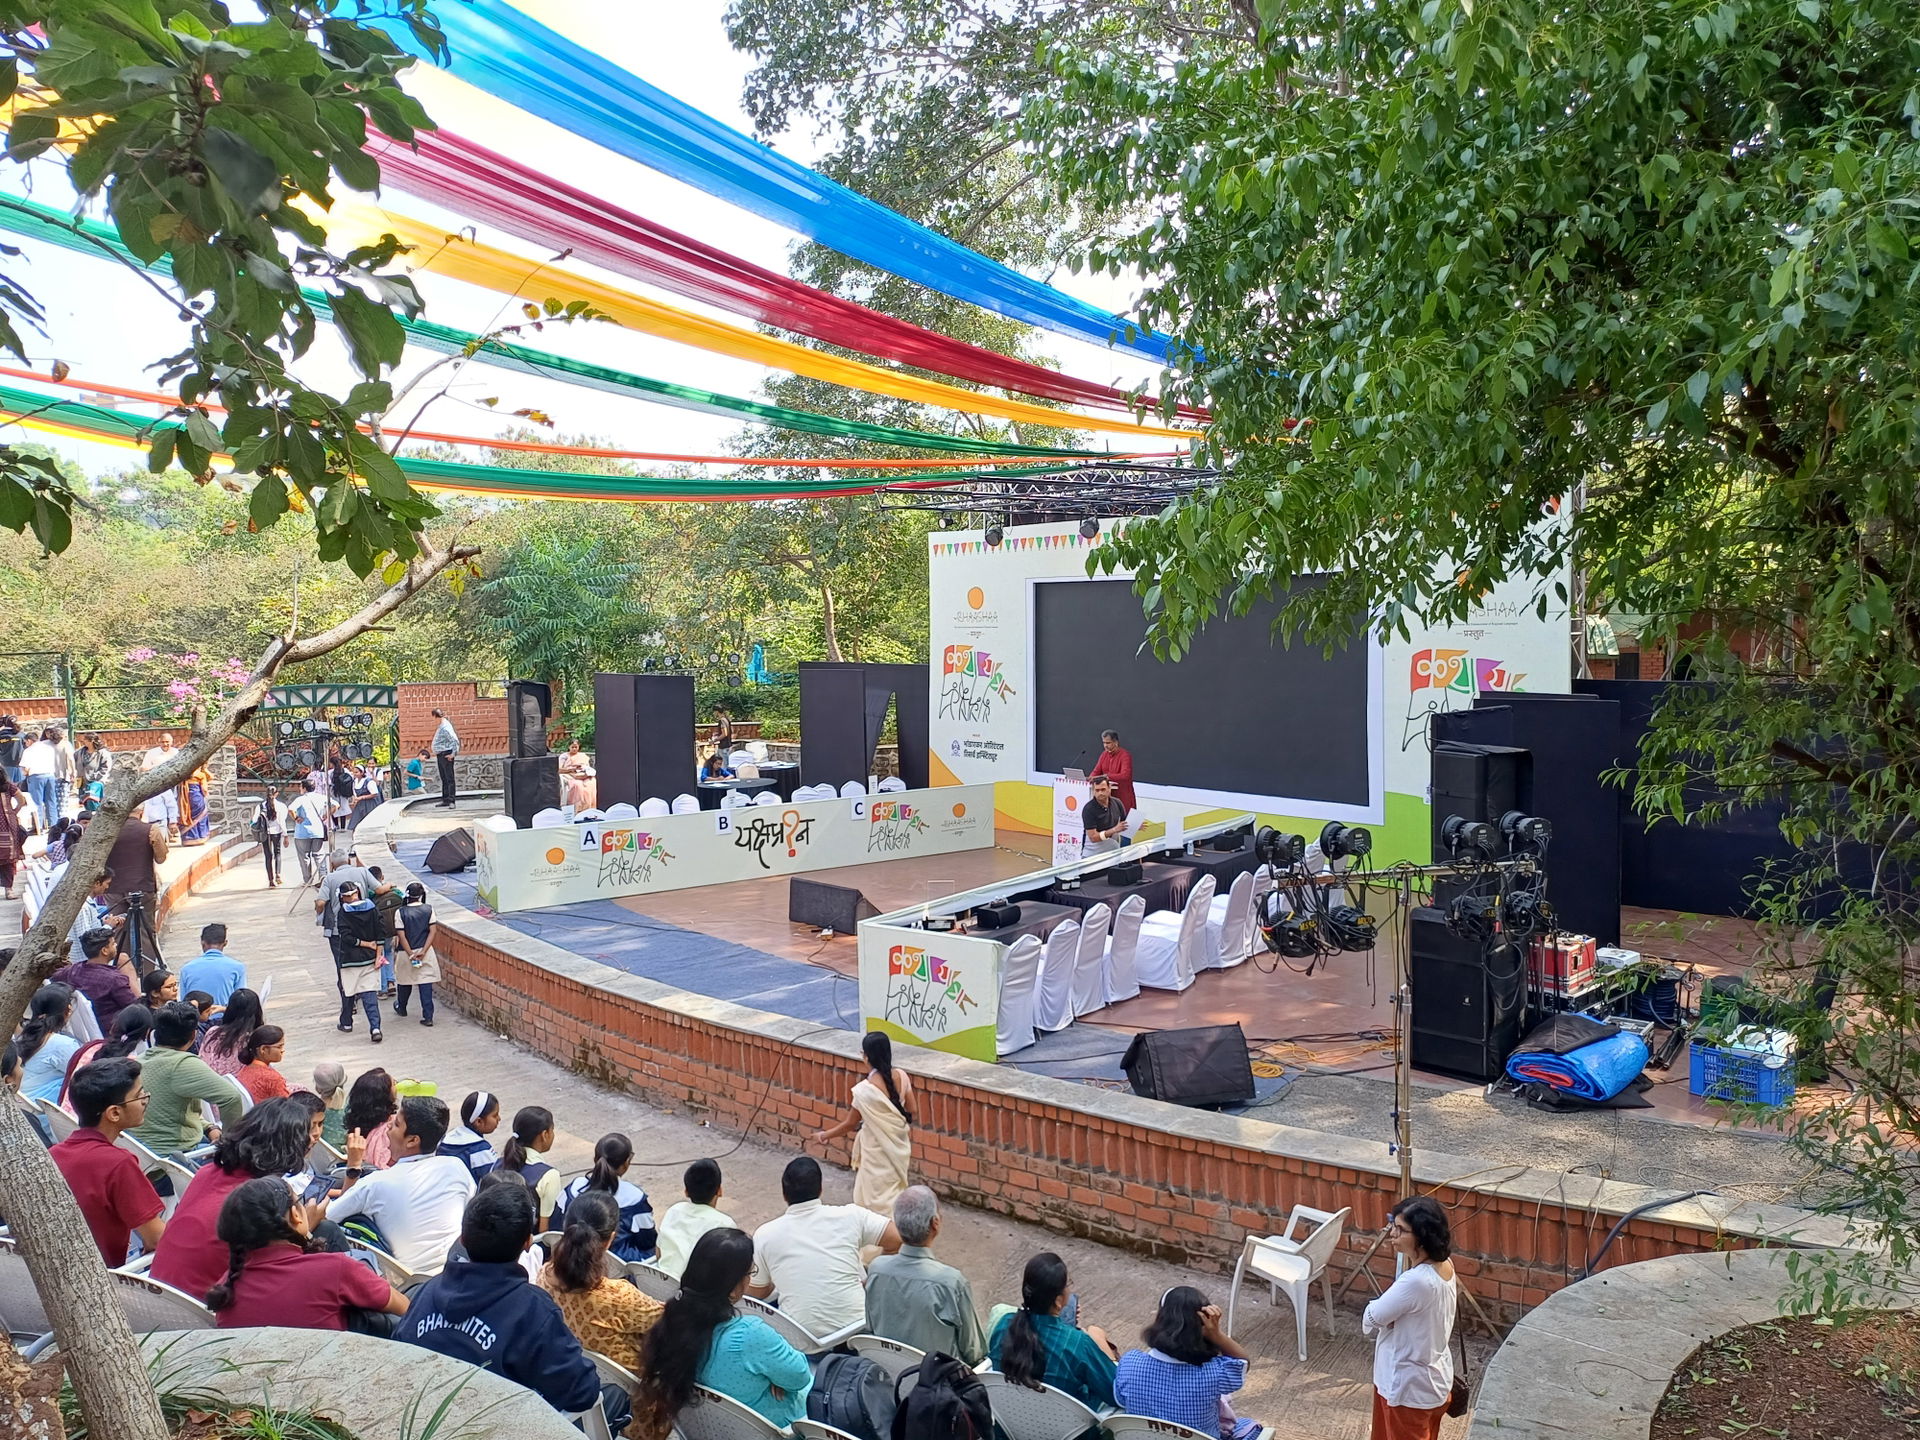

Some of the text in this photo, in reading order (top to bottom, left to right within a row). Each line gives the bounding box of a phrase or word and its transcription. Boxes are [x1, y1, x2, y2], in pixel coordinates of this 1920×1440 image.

[854, 802, 864, 816] C
[719, 816, 729, 830] B
[583, 830, 596, 846] A
